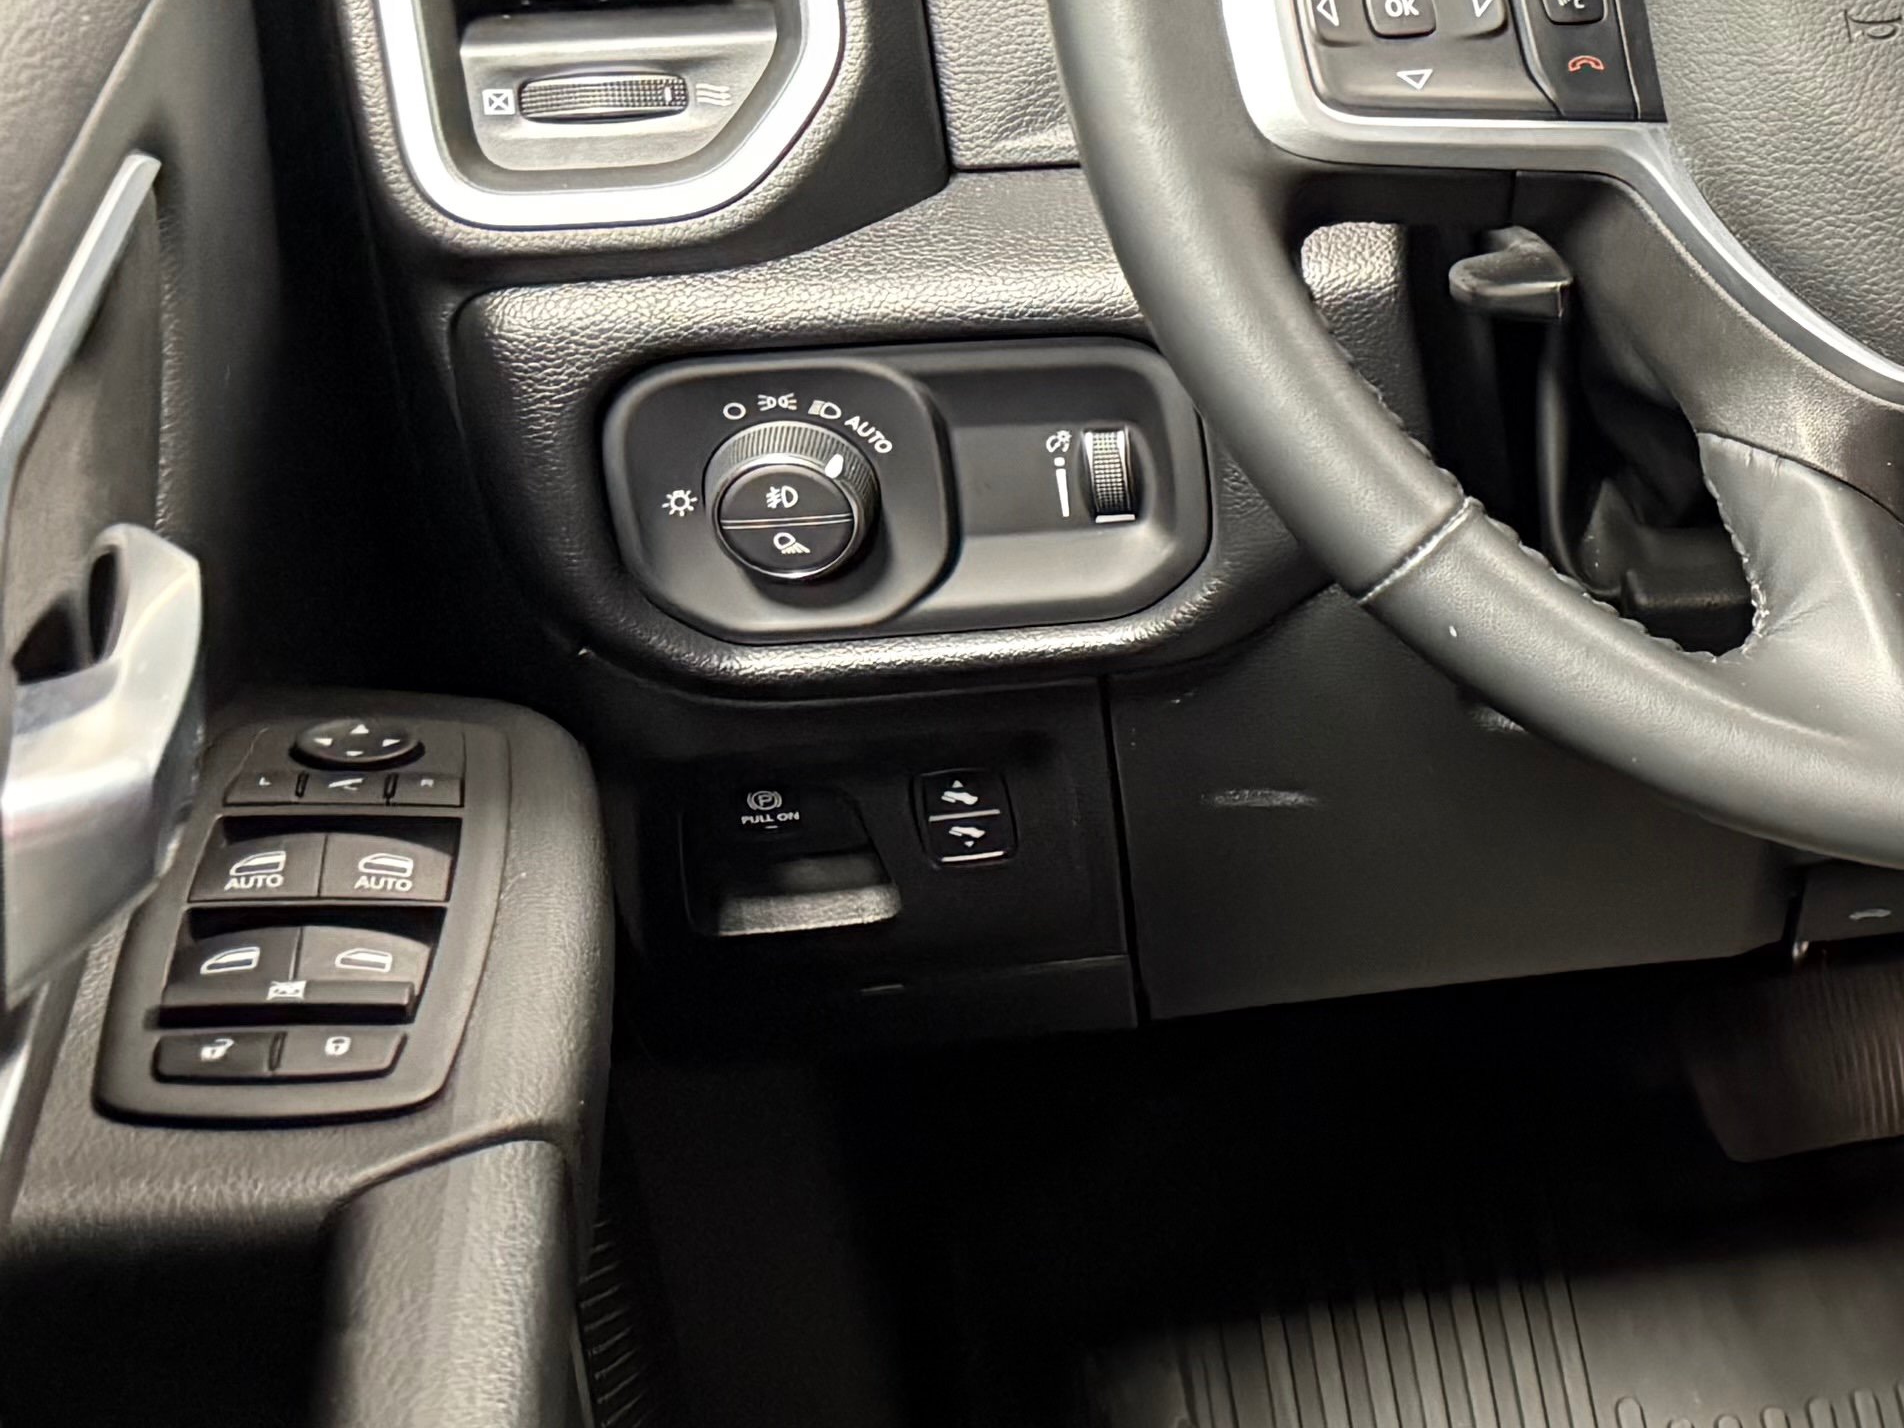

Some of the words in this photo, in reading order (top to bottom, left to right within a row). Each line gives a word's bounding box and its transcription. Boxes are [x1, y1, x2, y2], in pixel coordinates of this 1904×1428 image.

[844, 415, 893, 453] AUTO
[740, 813, 775, 825] PULL
[776, 811, 800, 822] ON
[224, 873, 285, 892] AUTO
[354, 874, 414, 892] AUTO
